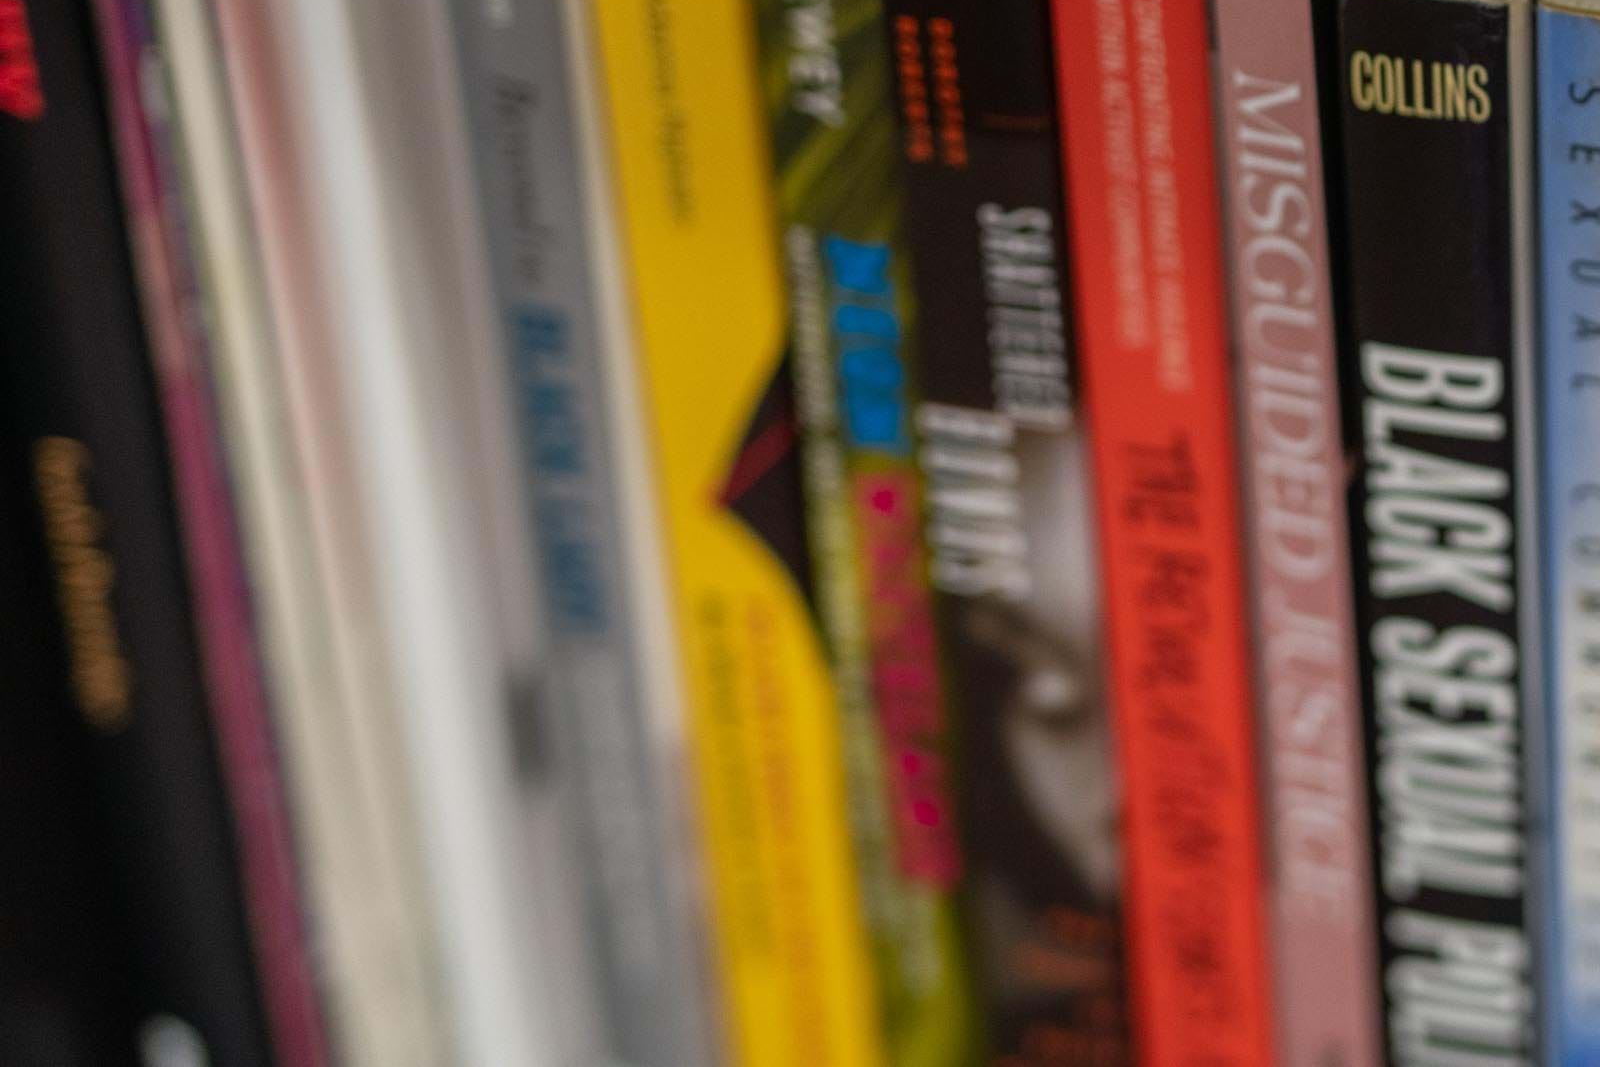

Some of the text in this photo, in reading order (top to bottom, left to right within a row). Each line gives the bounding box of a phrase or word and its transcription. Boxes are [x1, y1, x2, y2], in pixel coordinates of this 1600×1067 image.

[1349, 50, 1492, 125] COLLINS
[1232, 68, 1337, 583] MISGUIDED
[1359, 340, 1514, 615] BLACK
[1369, 615, 1528, 902] SEXUAL
